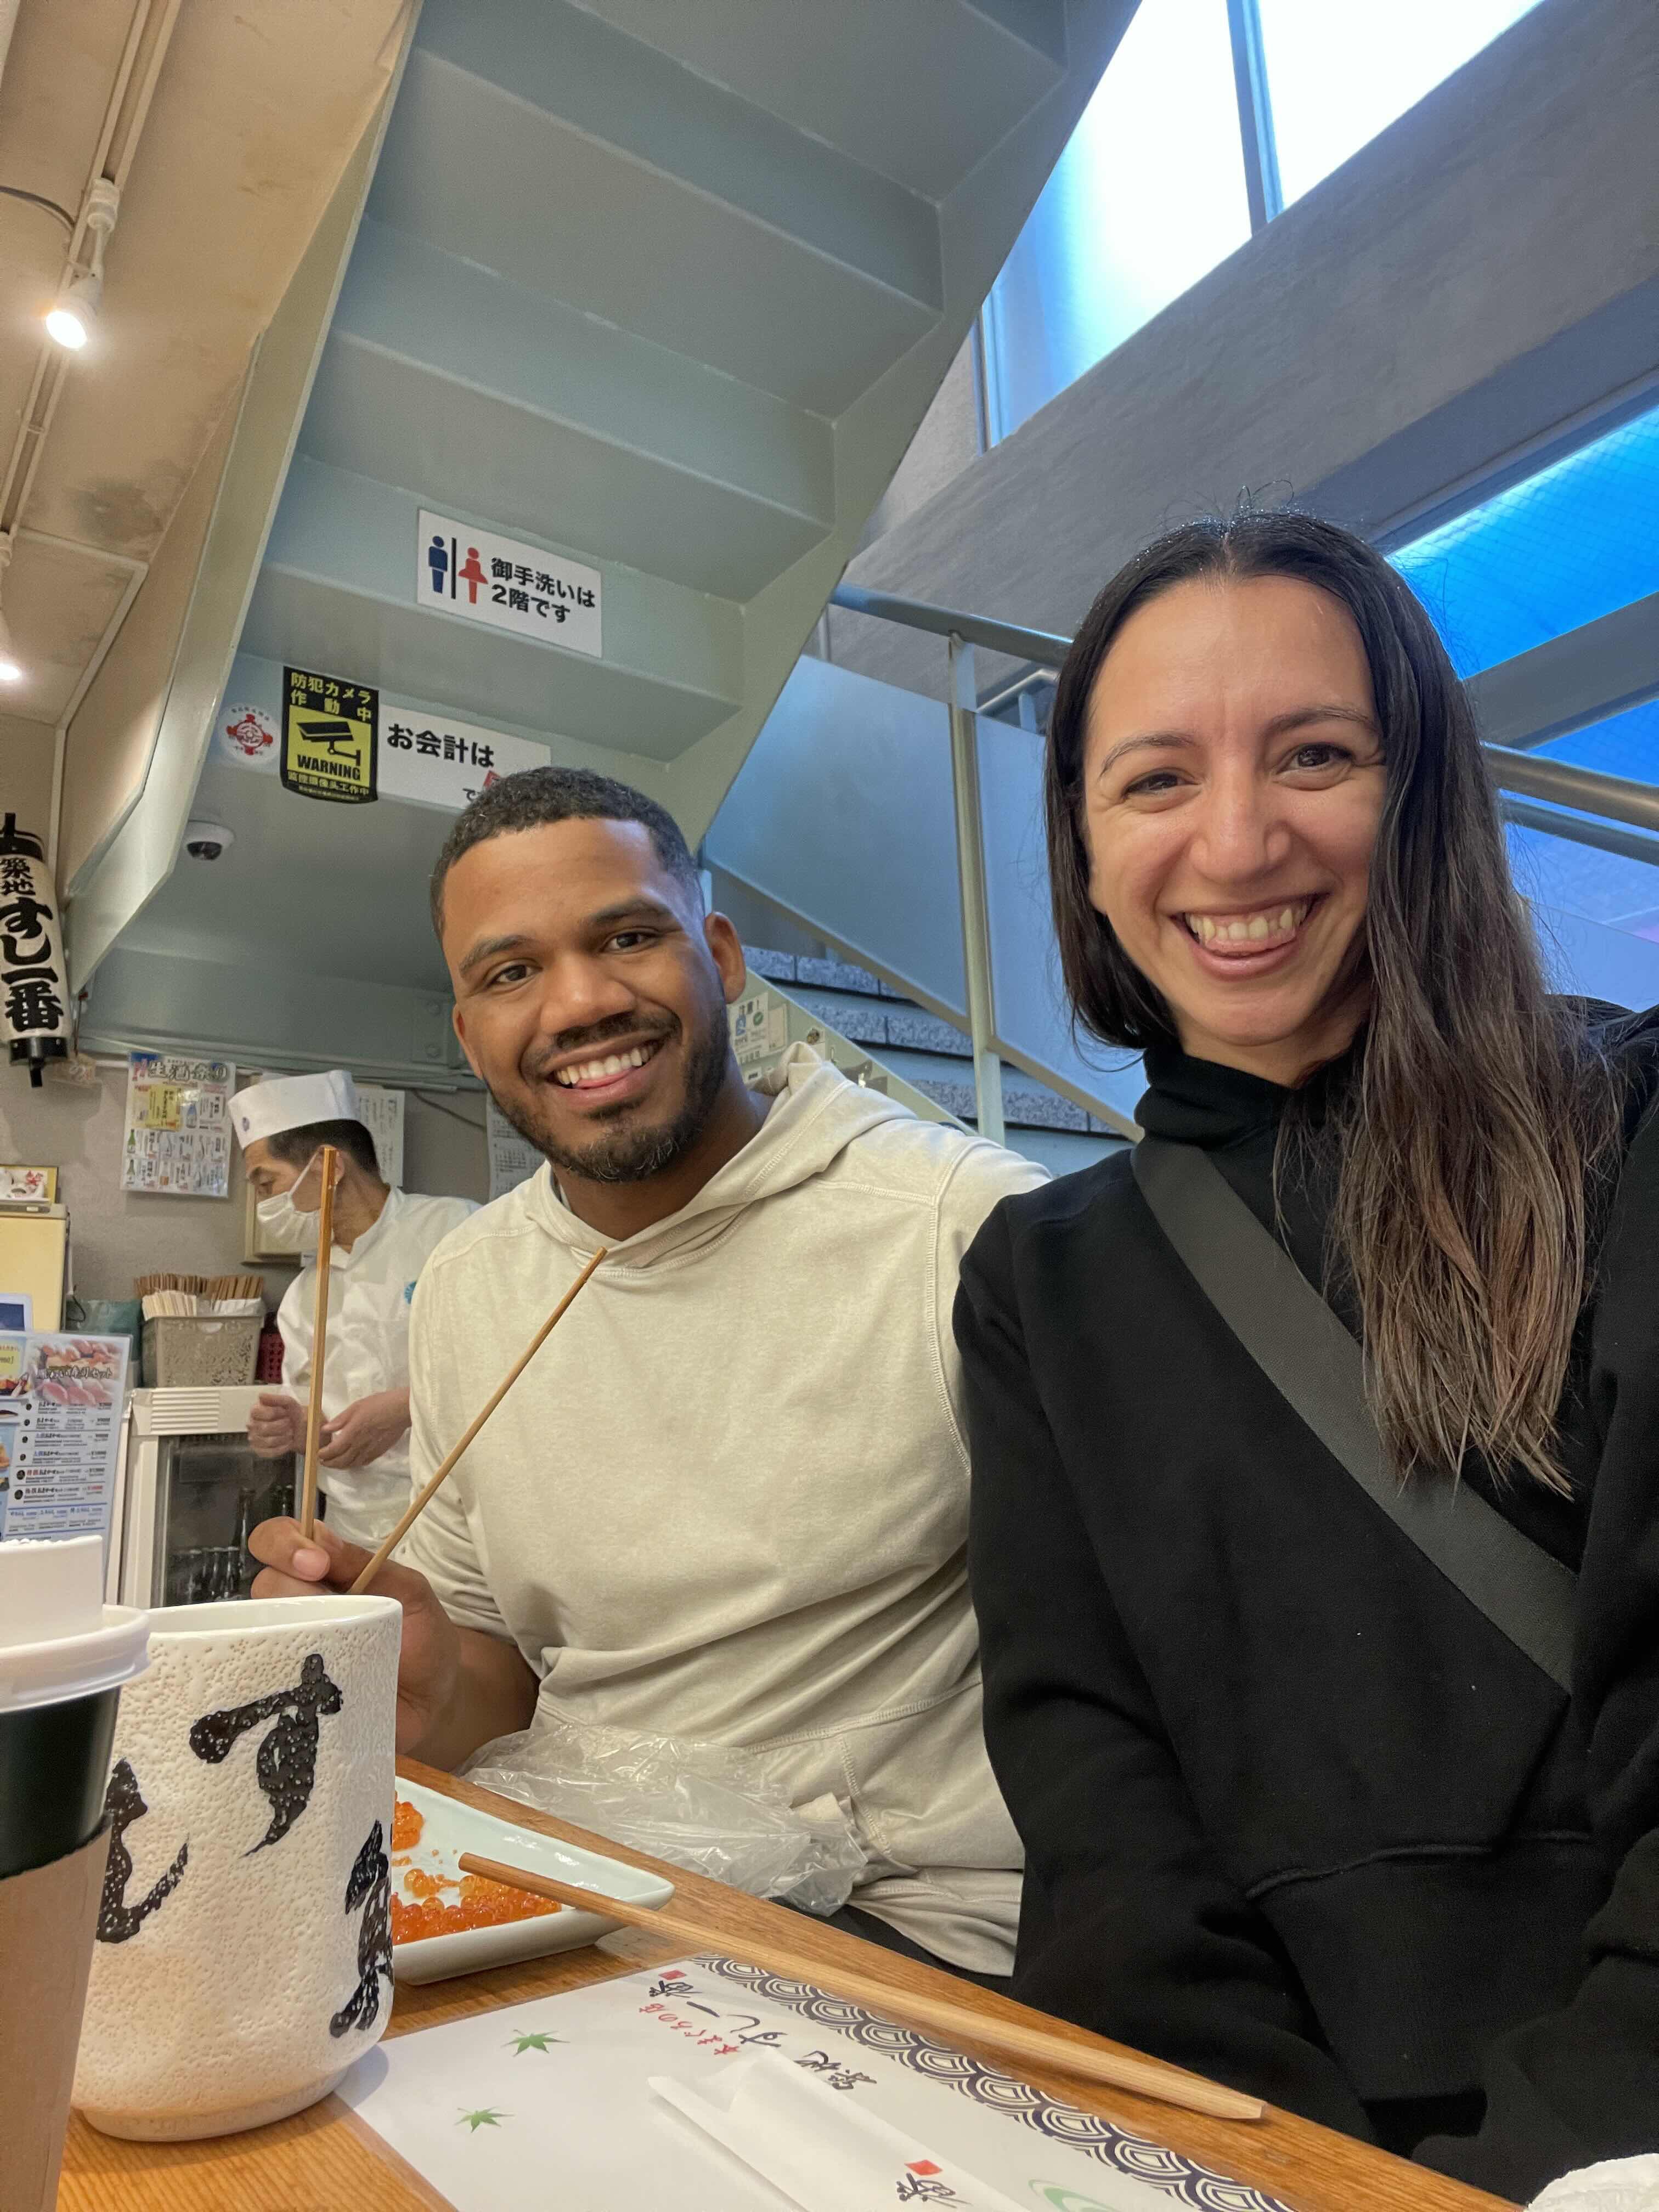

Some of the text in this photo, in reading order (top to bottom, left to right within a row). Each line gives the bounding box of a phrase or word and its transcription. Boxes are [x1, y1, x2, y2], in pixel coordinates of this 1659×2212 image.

[491, 558, 595, 608] 御手洗いは
[492, 584, 571, 623] 2階です
[291, 673, 371, 704] 防犯カメラ
[388, 724, 494, 768] お会計は
[297, 754, 361, 781] WARNING
[639, 2002, 742, 2056] 本まぐろの店
